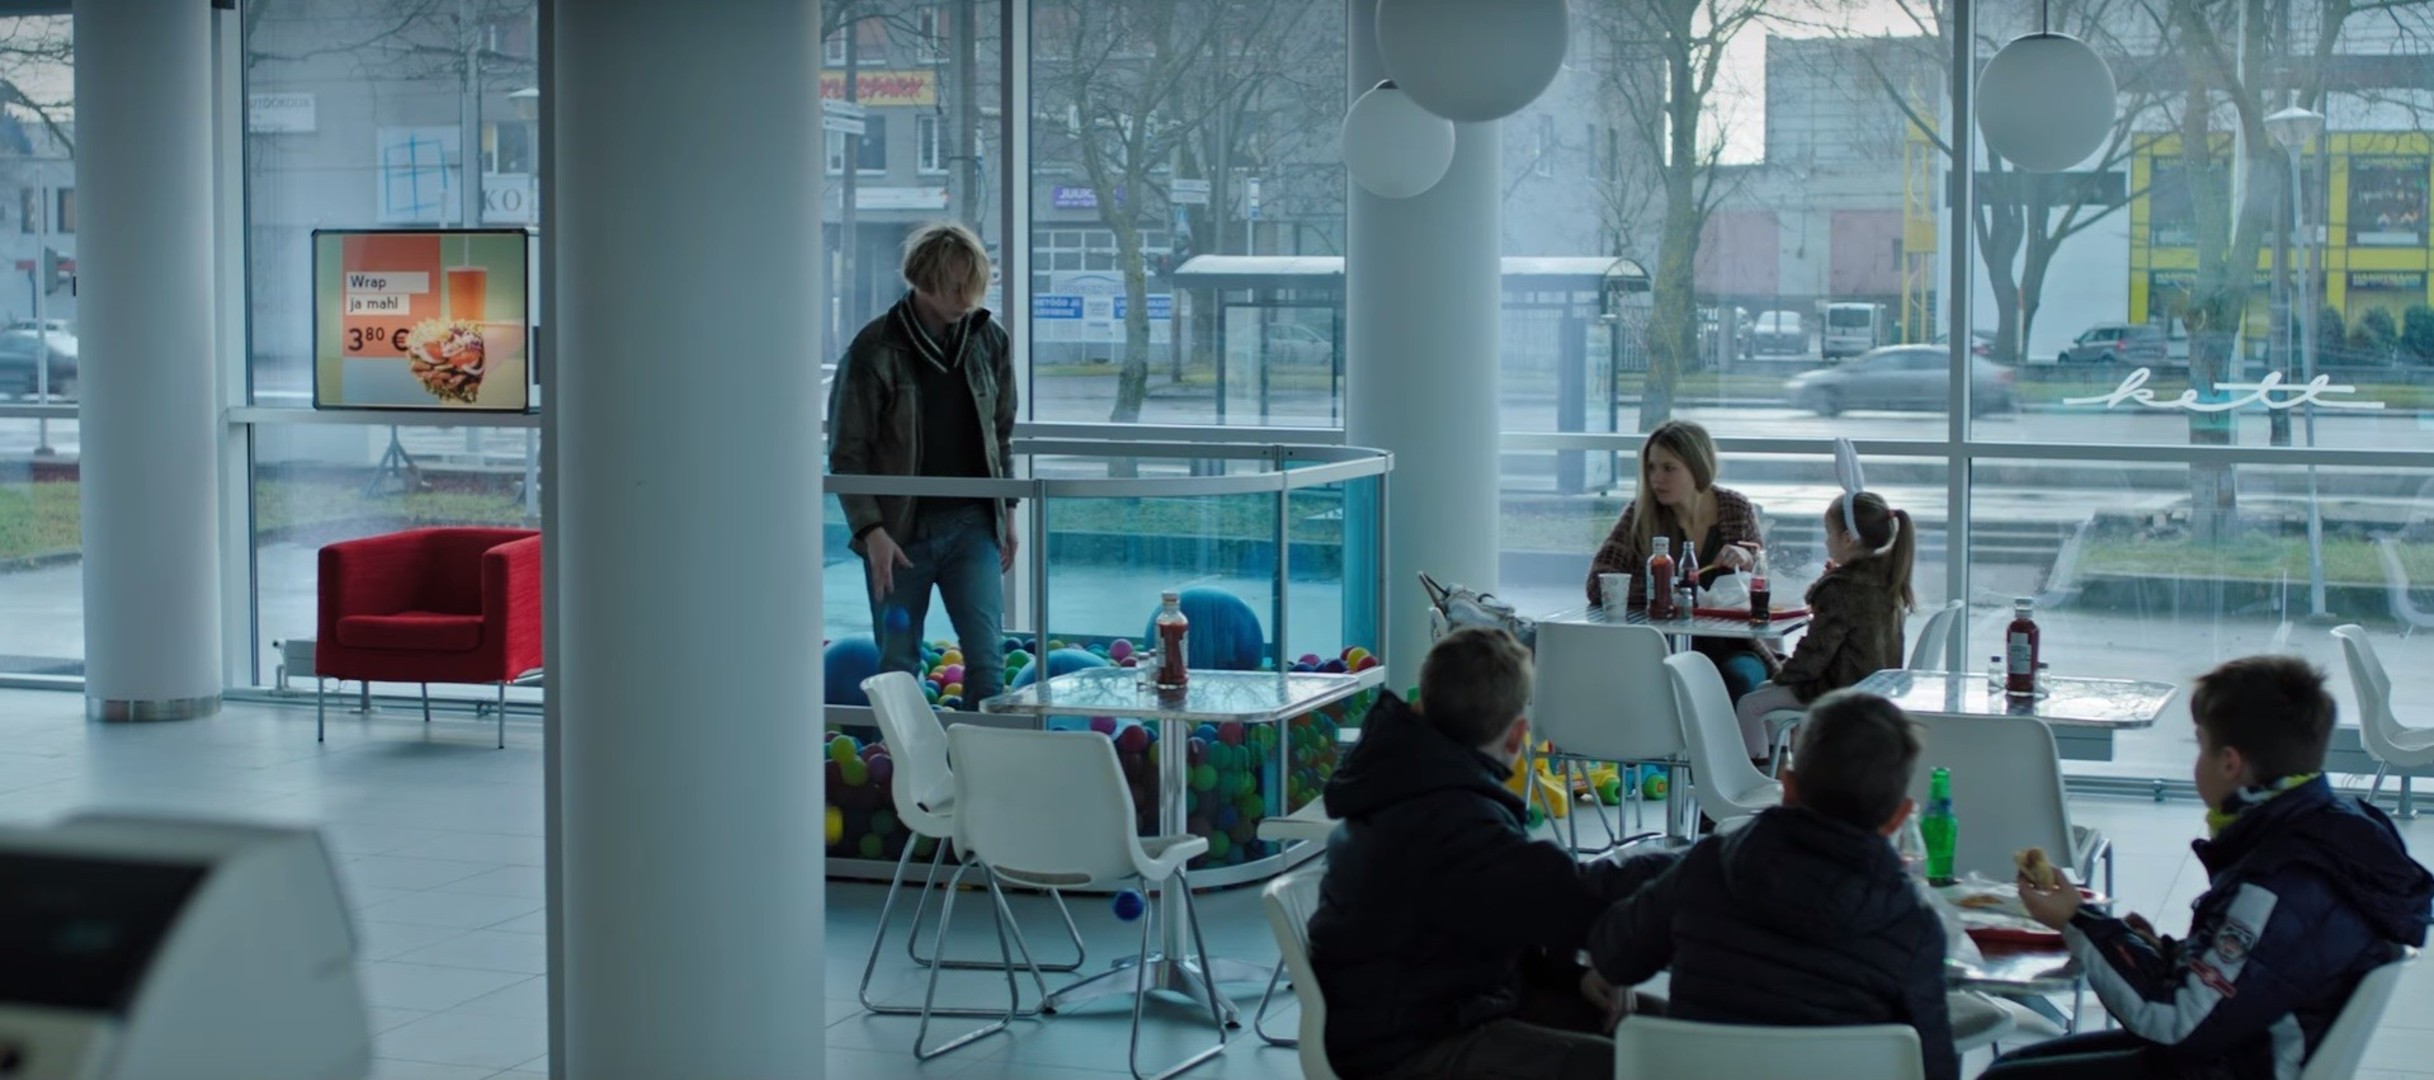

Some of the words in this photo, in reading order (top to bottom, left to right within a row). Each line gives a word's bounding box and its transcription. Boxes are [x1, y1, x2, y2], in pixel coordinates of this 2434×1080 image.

[350, 275, 387, 290] Wrap
[350, 297, 361, 312] ja
[367, 296, 398, 309] mahl
